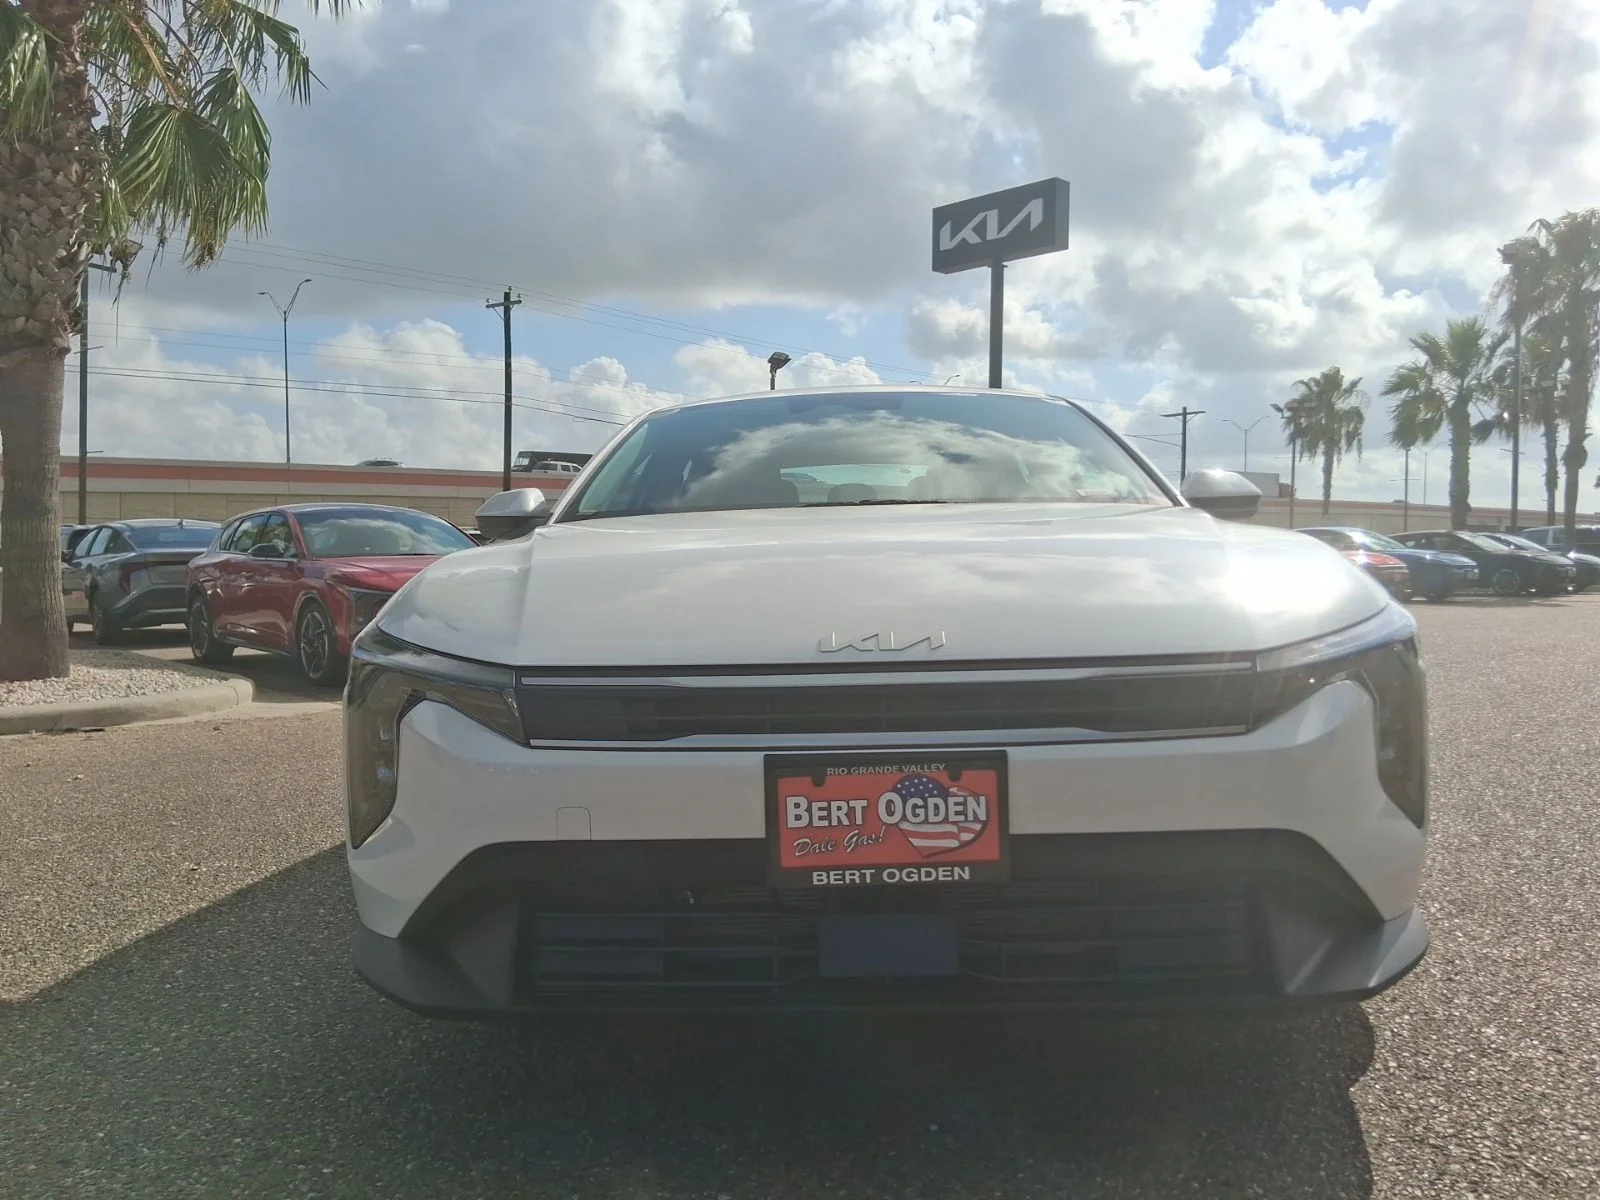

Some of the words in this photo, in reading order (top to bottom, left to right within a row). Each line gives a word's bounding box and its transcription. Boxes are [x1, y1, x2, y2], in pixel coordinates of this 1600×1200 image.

[826, 767, 848, 776] RIO
[850, 765, 900, 775] GRANDE
[901, 763, 946, 774] VALLEY
[785, 796, 868, 828] BERT
[877, 791, 988, 825] OGDEN
[793, 837, 836, 857] Dale
[843, 825, 886, 854] Gas!
[812, 869, 876, 886] BERT
[882, 866, 971, 882] OGDEN
